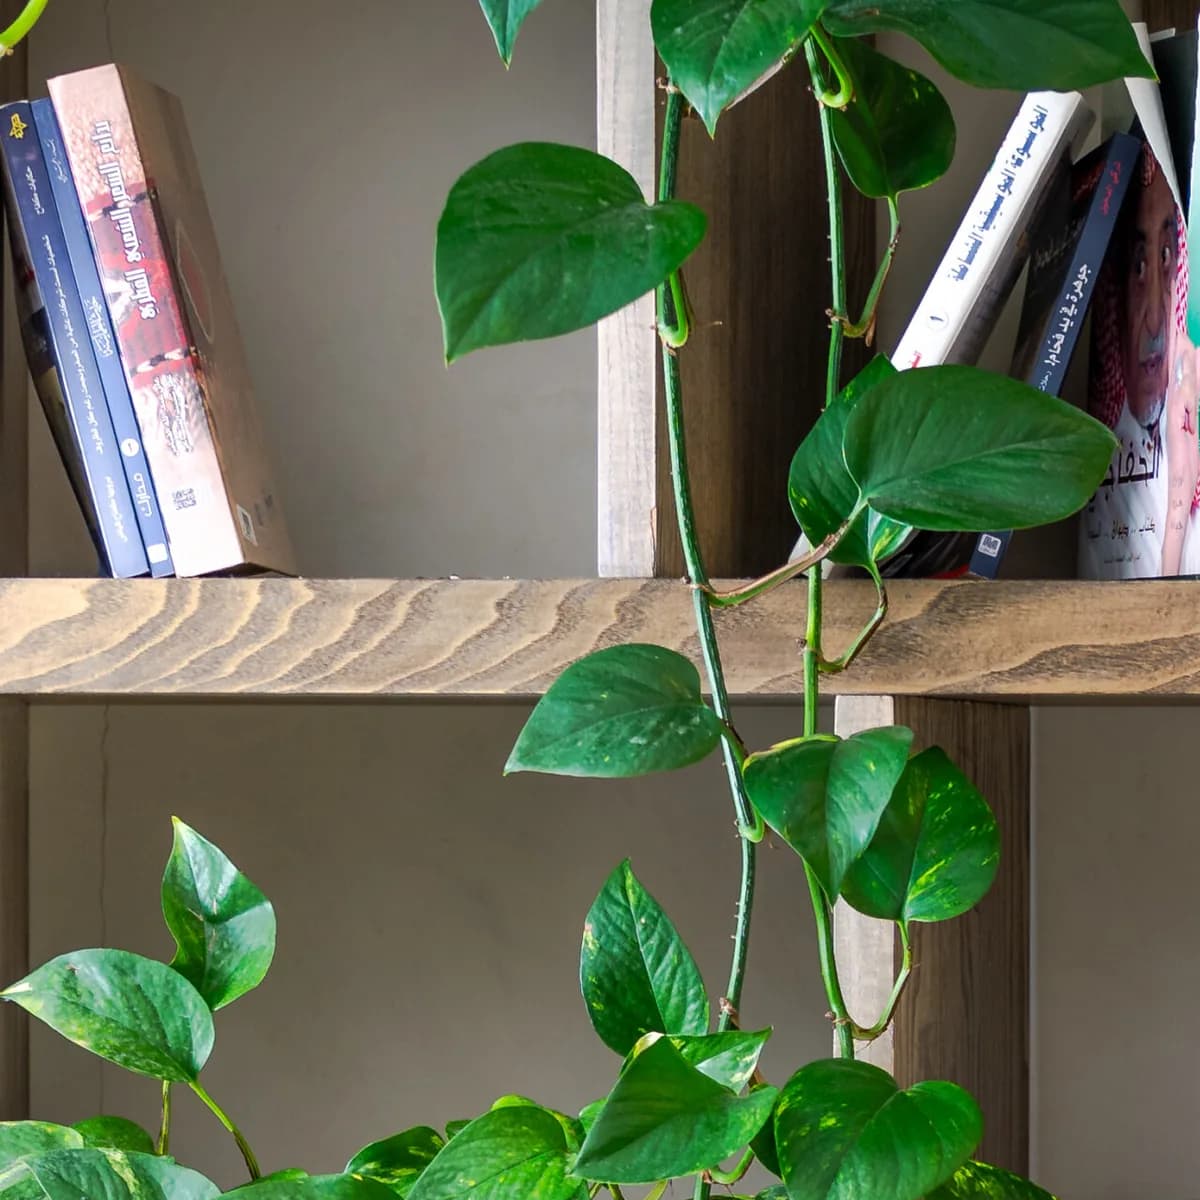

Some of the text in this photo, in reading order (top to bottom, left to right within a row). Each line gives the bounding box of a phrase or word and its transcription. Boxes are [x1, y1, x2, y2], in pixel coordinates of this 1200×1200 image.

[949, 105, 1048, 282] الموسوعة الموسيقية الشاملة
[1066, 264, 1091, 302] جوهرة
[1060, 304, 1077, 316] في
[1059, 318, 1073, 332] يد
